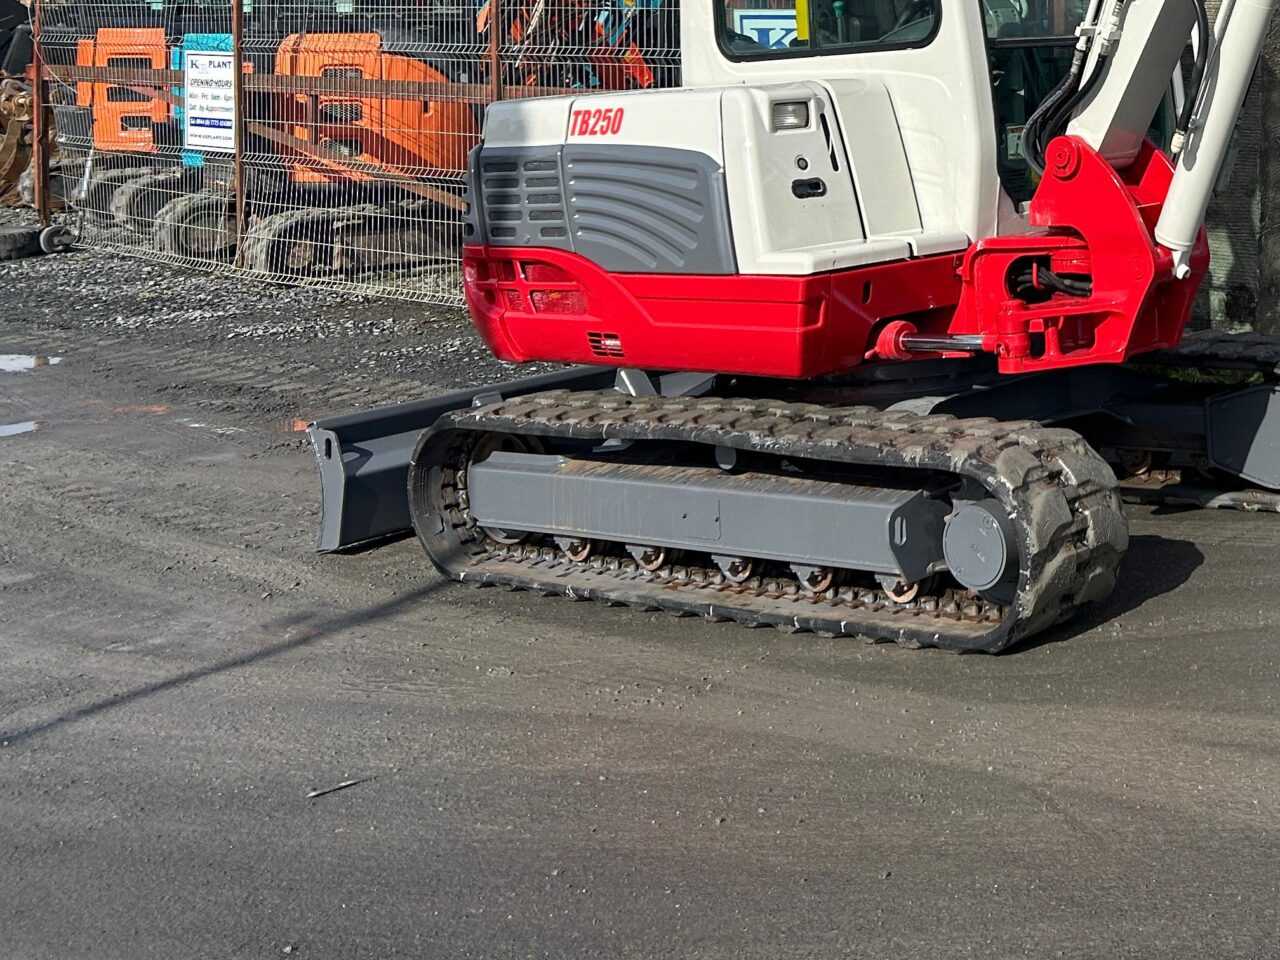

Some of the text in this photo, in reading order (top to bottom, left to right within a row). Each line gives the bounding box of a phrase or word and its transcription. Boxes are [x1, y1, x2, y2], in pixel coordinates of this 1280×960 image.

[208, 60, 232, 69] PLANT
[190, 79, 232, 88] OPENING HOURS
[570, 108, 624, 136] TB250
